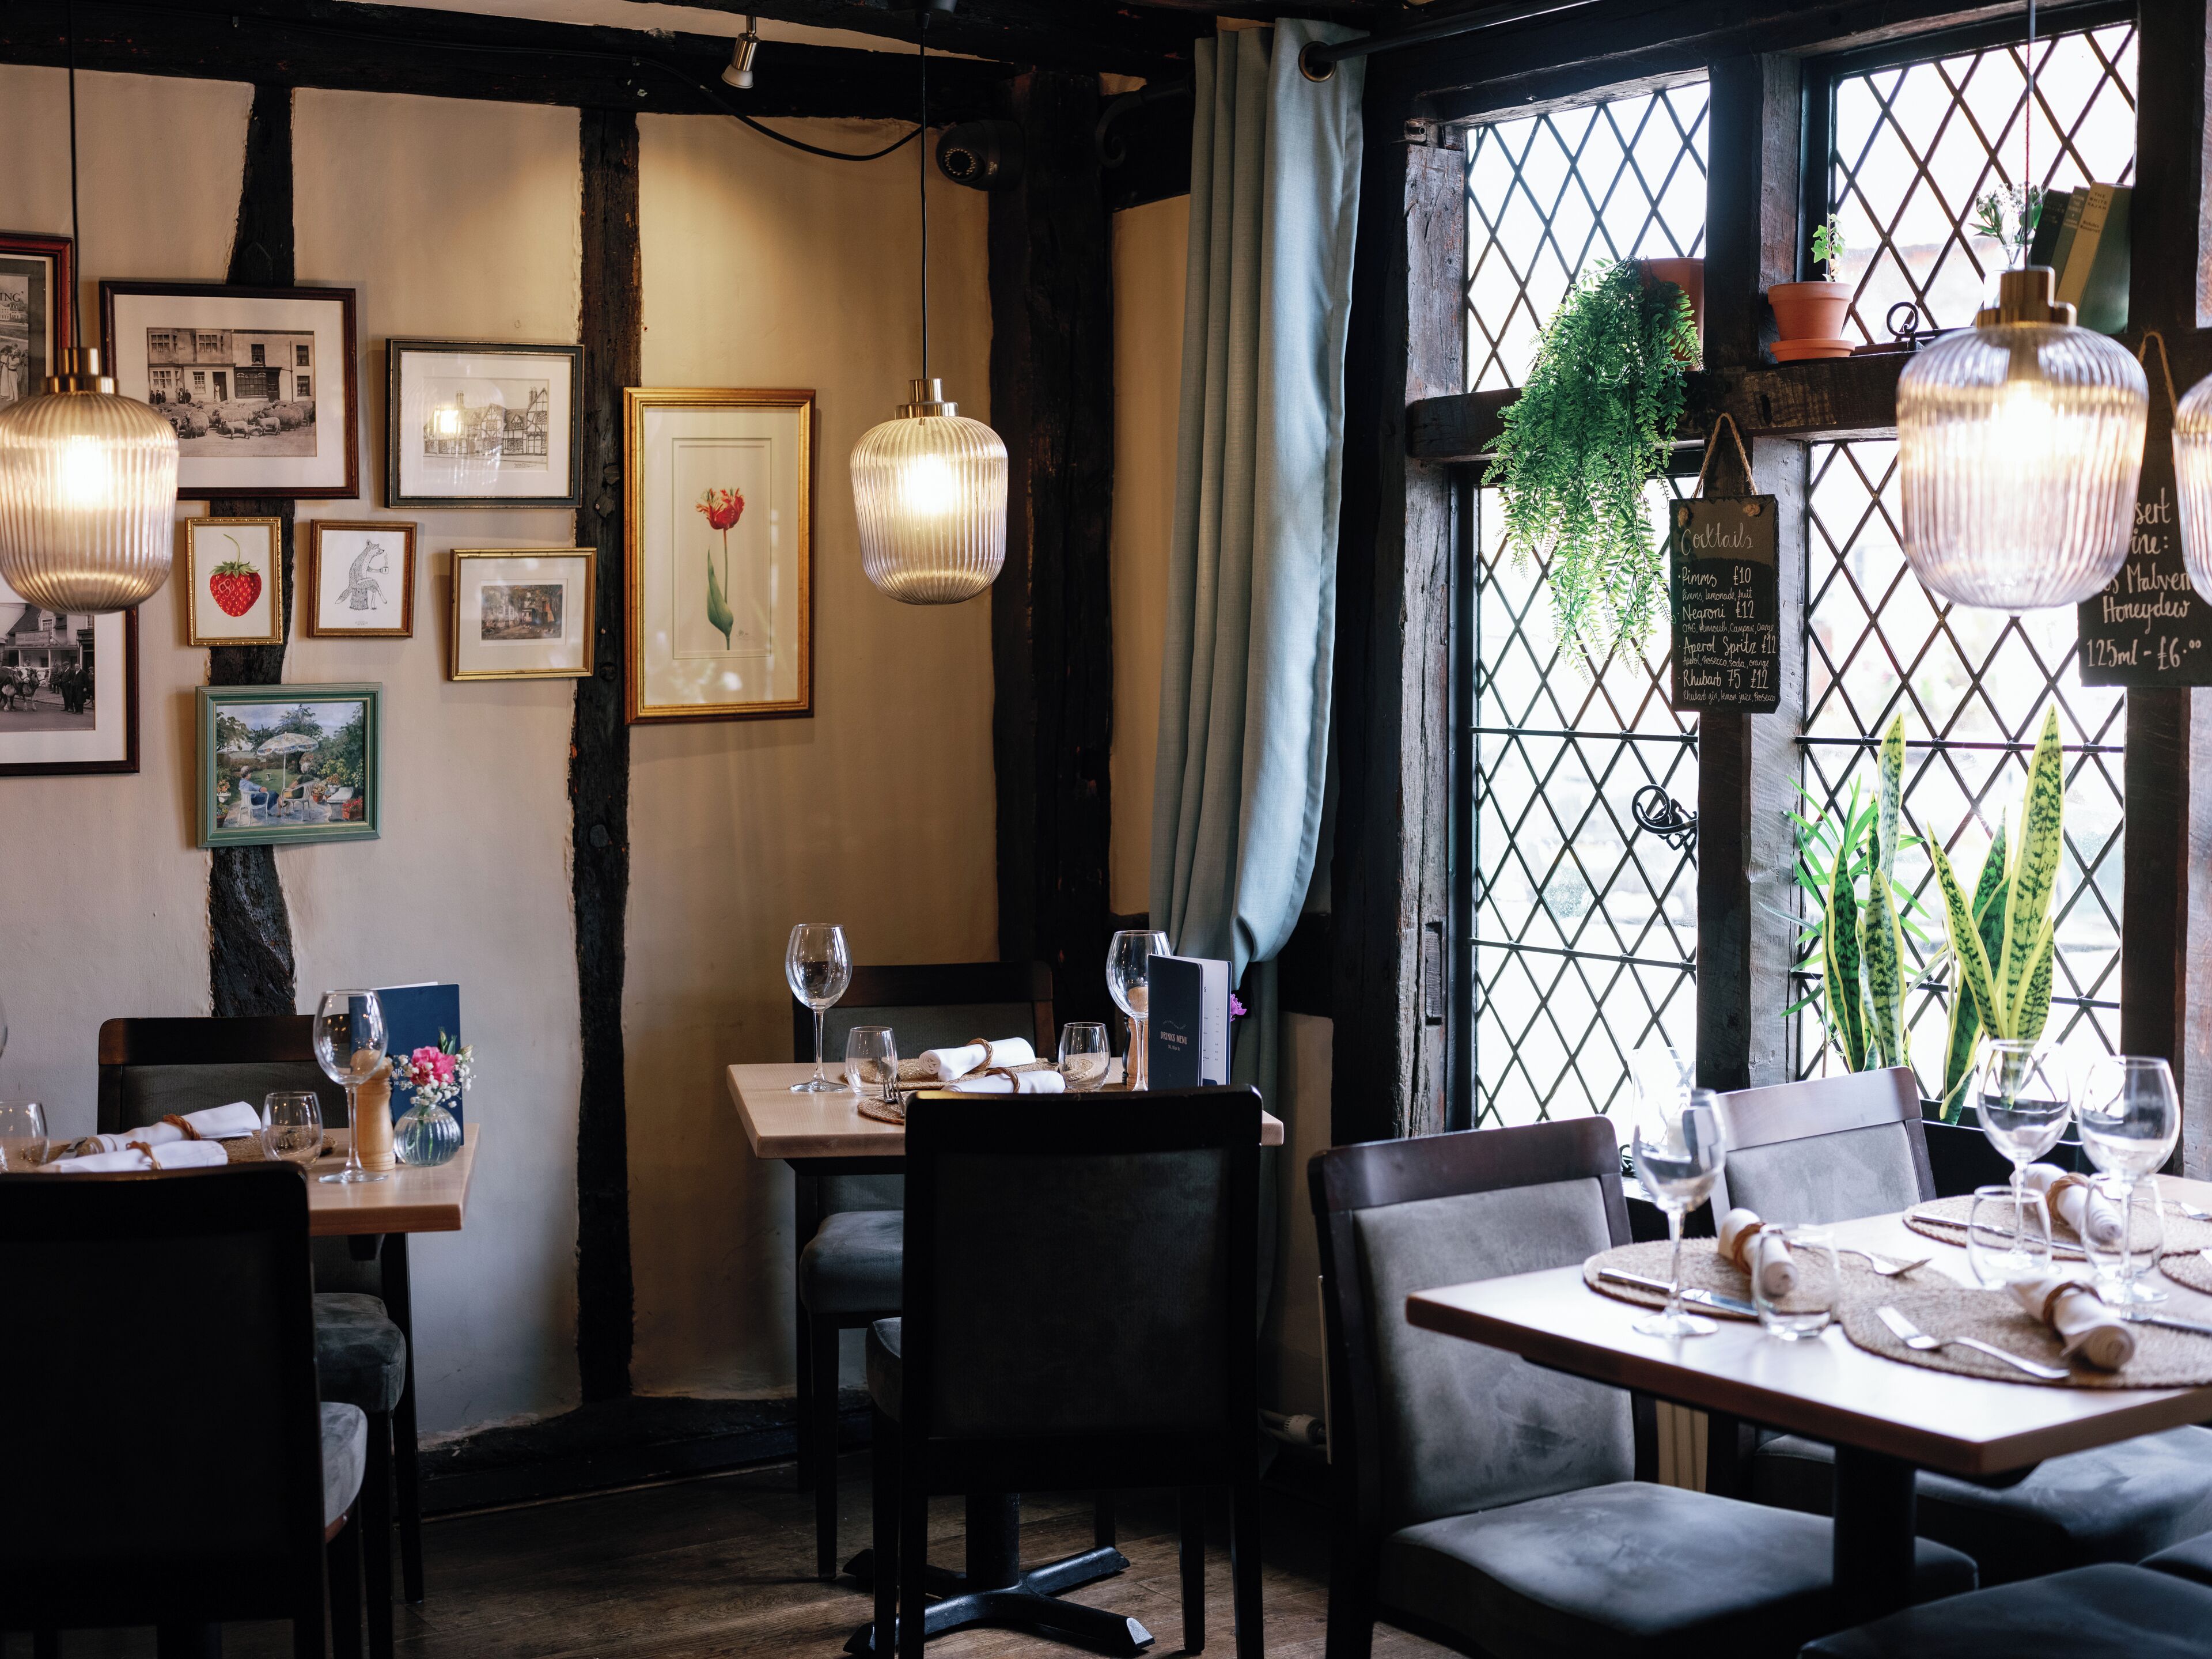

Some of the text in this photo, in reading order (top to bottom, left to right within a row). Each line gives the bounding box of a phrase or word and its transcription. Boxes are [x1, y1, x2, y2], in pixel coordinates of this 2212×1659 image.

[2135, 487, 2171, 525] sert
[1681, 522, 1753, 556] Cocktails
[2130, 528, 2168, 554] ine:
[1682, 566, 1751, 586] Pimms £10
[1683, 600, 1755, 626] Negroni £12
[2103, 592, 2190, 634] Honeydew
[1683, 633, 1777, 658] Aperol Spritz £12
[2086, 638, 2138, 667] 125ml
[1683, 669, 1769, 689] Rhubarb 75 £12
[1683, 690, 1707, 702] Rhubarb
[1160, 1031, 1188, 1045] DRINKS MENU
